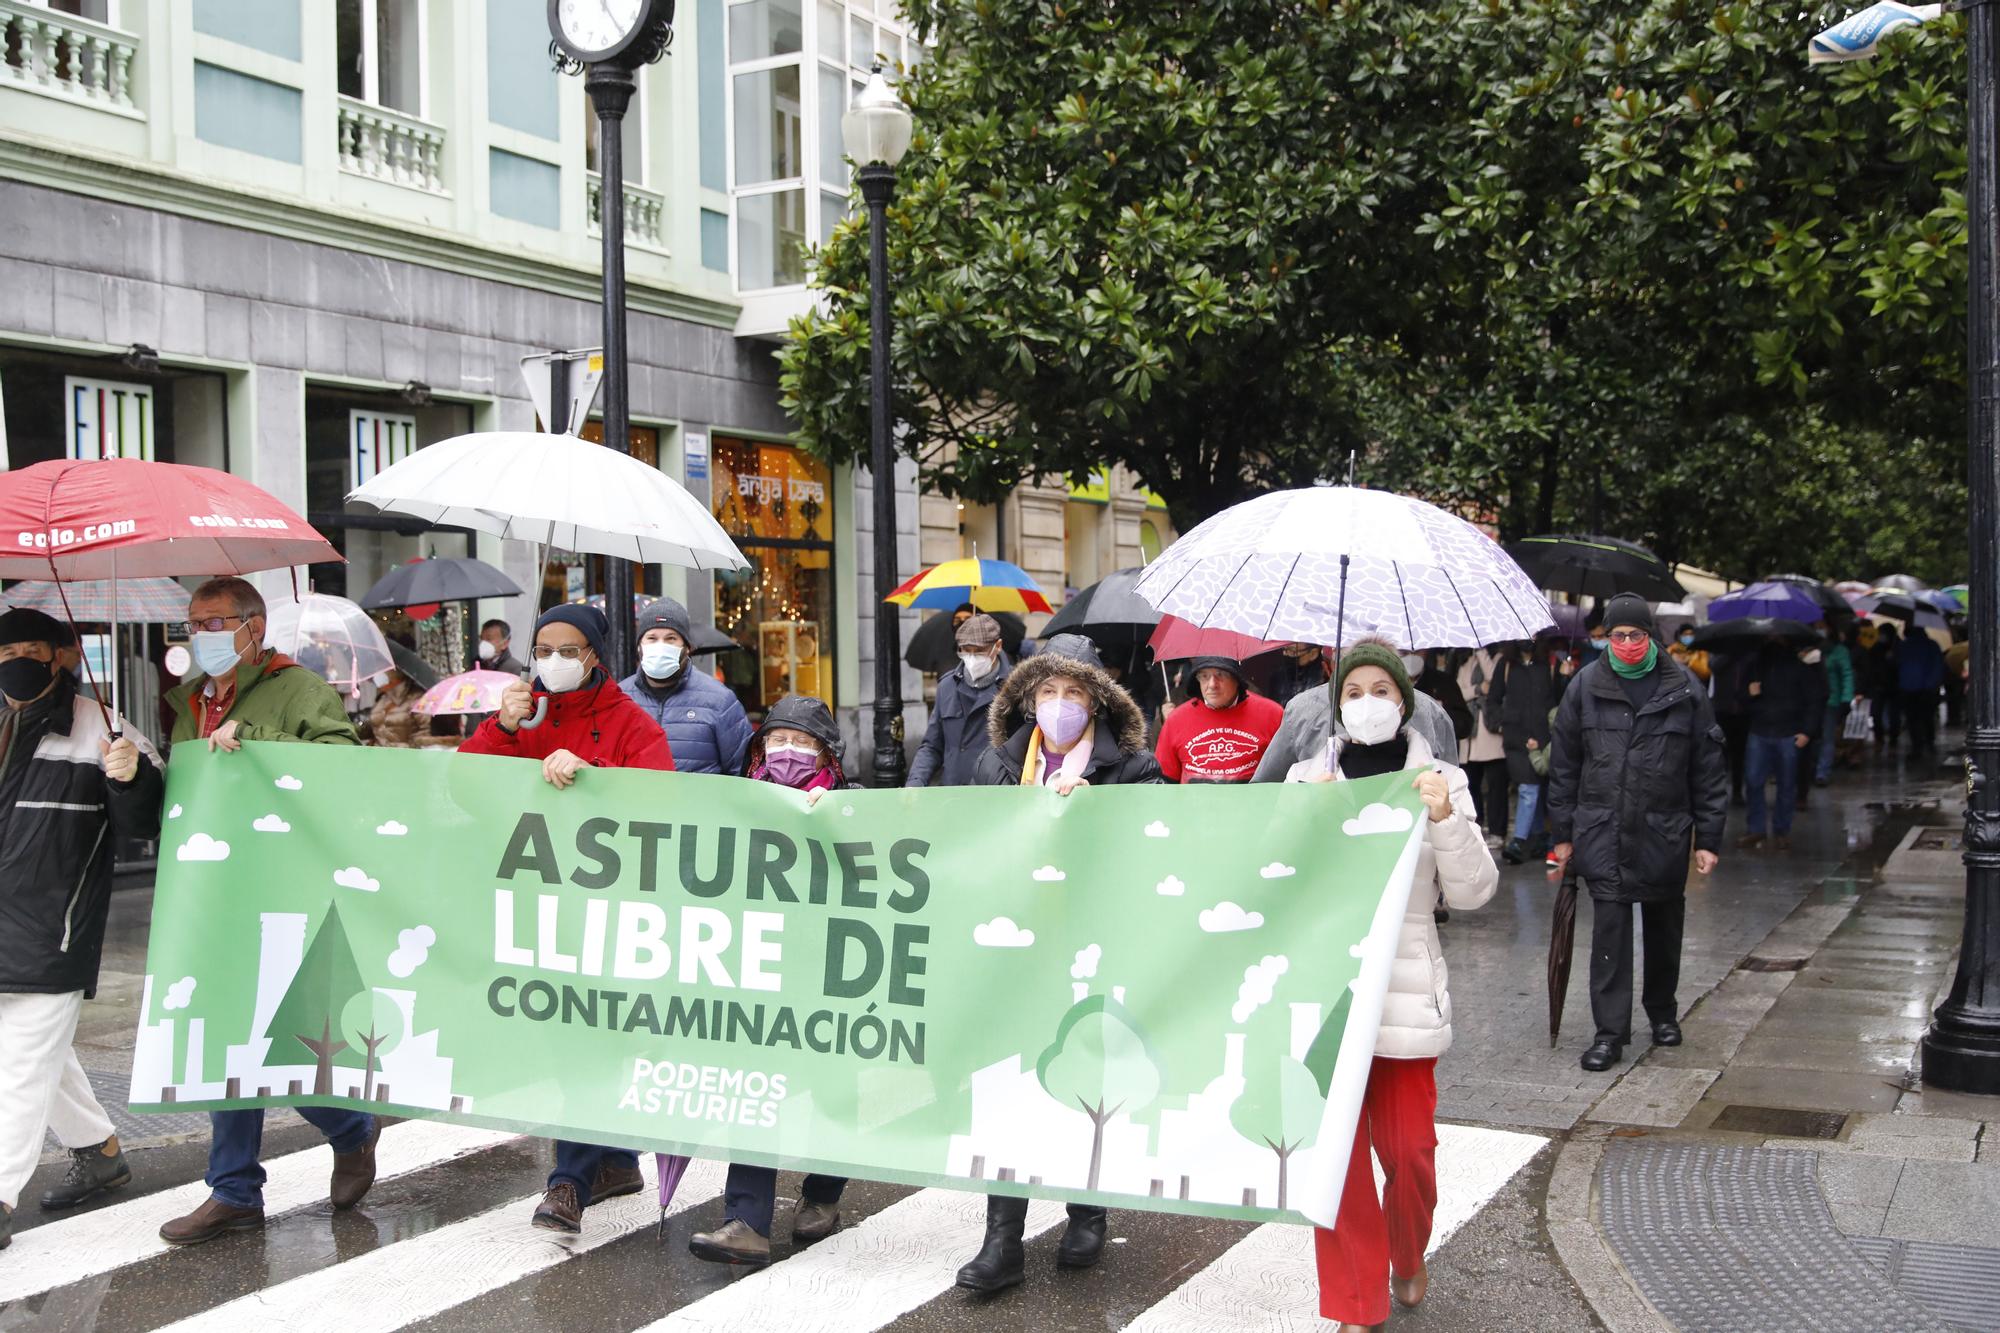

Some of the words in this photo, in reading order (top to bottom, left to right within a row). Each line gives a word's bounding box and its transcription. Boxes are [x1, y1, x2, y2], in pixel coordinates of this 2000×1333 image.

[587, 31, 594, 43] 7
[600, 34, 609, 46] 6
[74, 385, 149, 461] FITT
[18, 518, 136, 548] eolo.com
[188, 514, 289, 530] eolo.com
[1209, 743, 1236, 753] A.P.G.
[496, 812, 931, 914] ASTURIES
[494, 889, 785, 992] LLIBRE
[823, 917, 930, 1007] DE
[487, 975, 926, 1065] CONTAMINACIÓN
[632, 1058, 787, 1102] PODEMOS
[618, 1084, 778, 1128] ASTURIES
